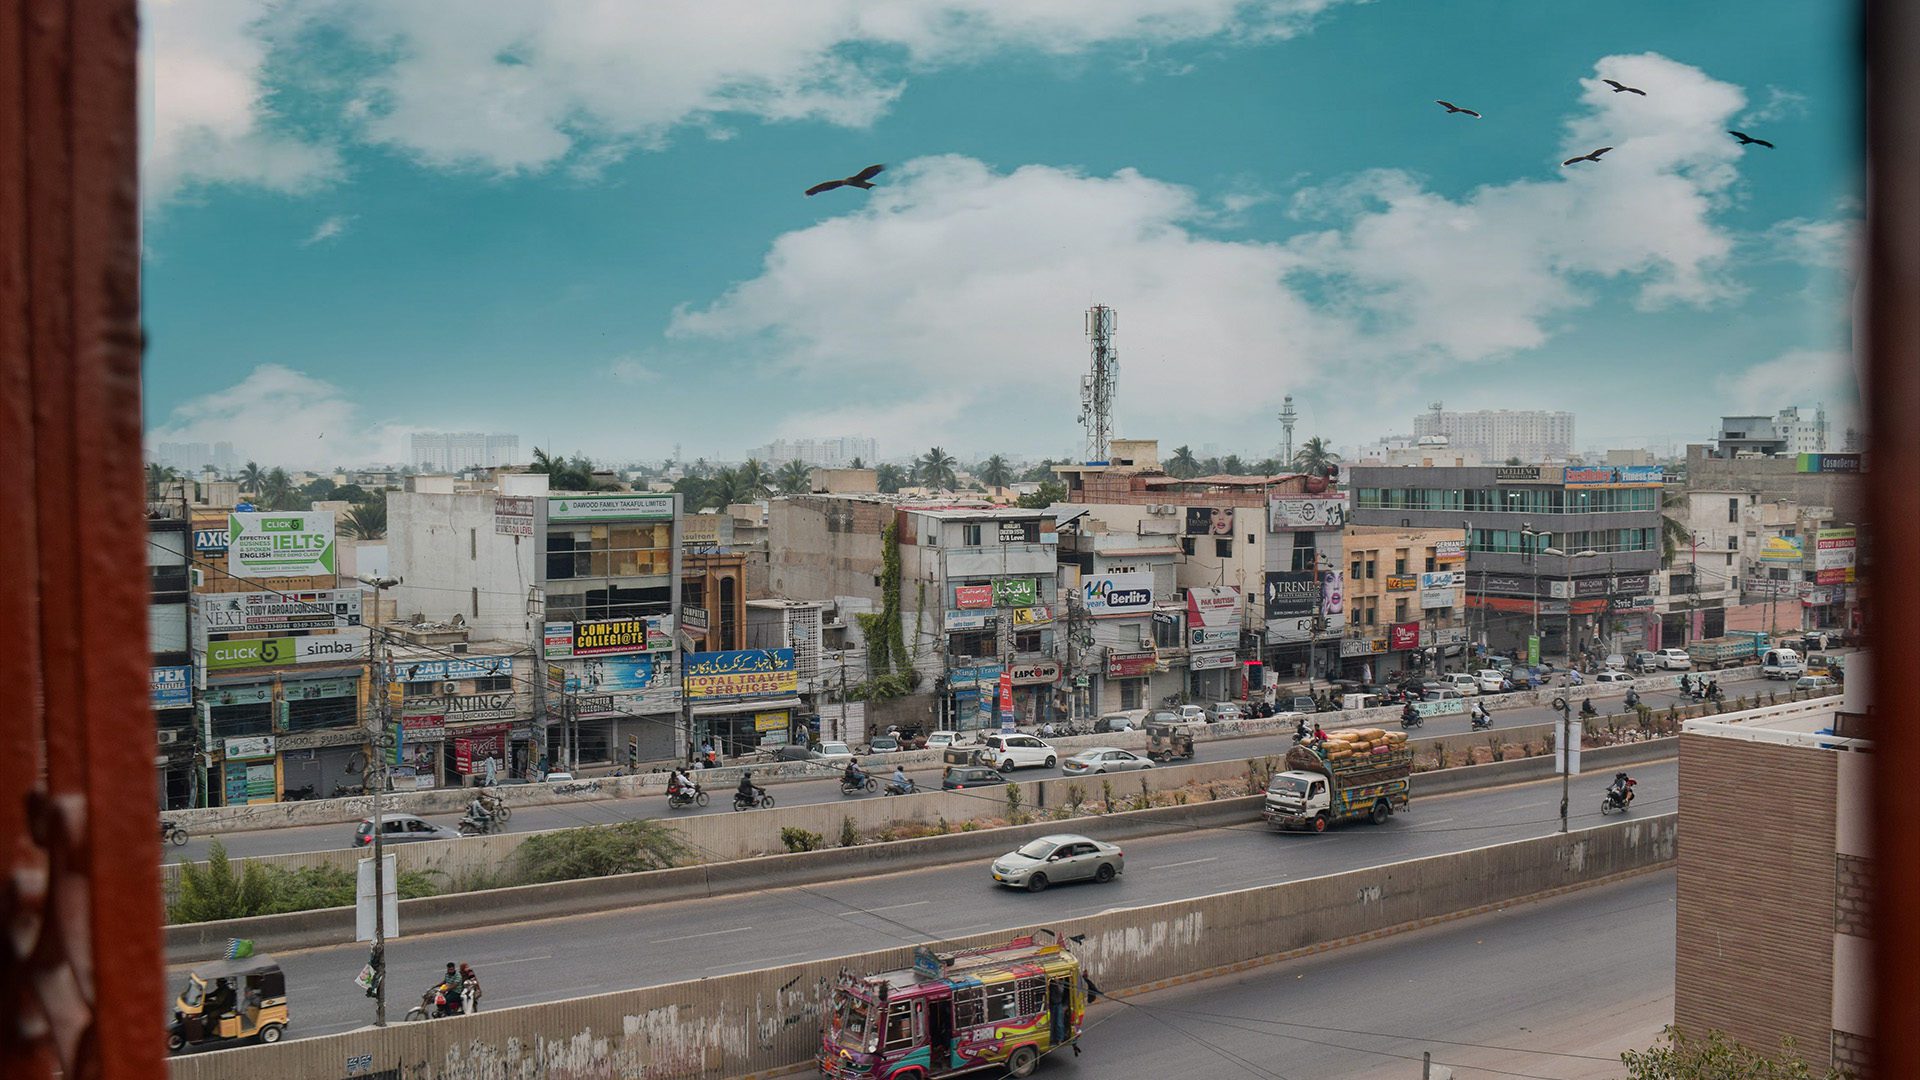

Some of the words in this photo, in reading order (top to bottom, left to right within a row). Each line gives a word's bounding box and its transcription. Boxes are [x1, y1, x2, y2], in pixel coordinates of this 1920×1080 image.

[273, 534, 326, 550] IELTS
[1084, 580, 1114, 600] 140
[1111, 591, 1146, 604] Berlitz
[206, 601, 221, 611] The
[246, 605, 266, 616] STUDY
[268, 604, 294, 615] ABROAD
[294, 602, 334, 614] CONSULTANT
[683, 606, 705, 618] COMPUTER
[206, 611, 244, 625] NEXT
[581, 622, 640, 636] COMPUTER
[578, 633, 643, 648] COLLEGI@TE
[307, 640, 352, 655] simba
[150, 669, 185, 682] PEX
[690, 676, 735, 686] TOTAL
[739, 672, 793, 683] TRAVEL
[151, 681, 185, 689] NSTITUTE
[705, 683, 778, 695] SERVICES
[464, 712, 499, 720] QUICKBOOKS
[278, 736, 313, 748] SCHOOL
